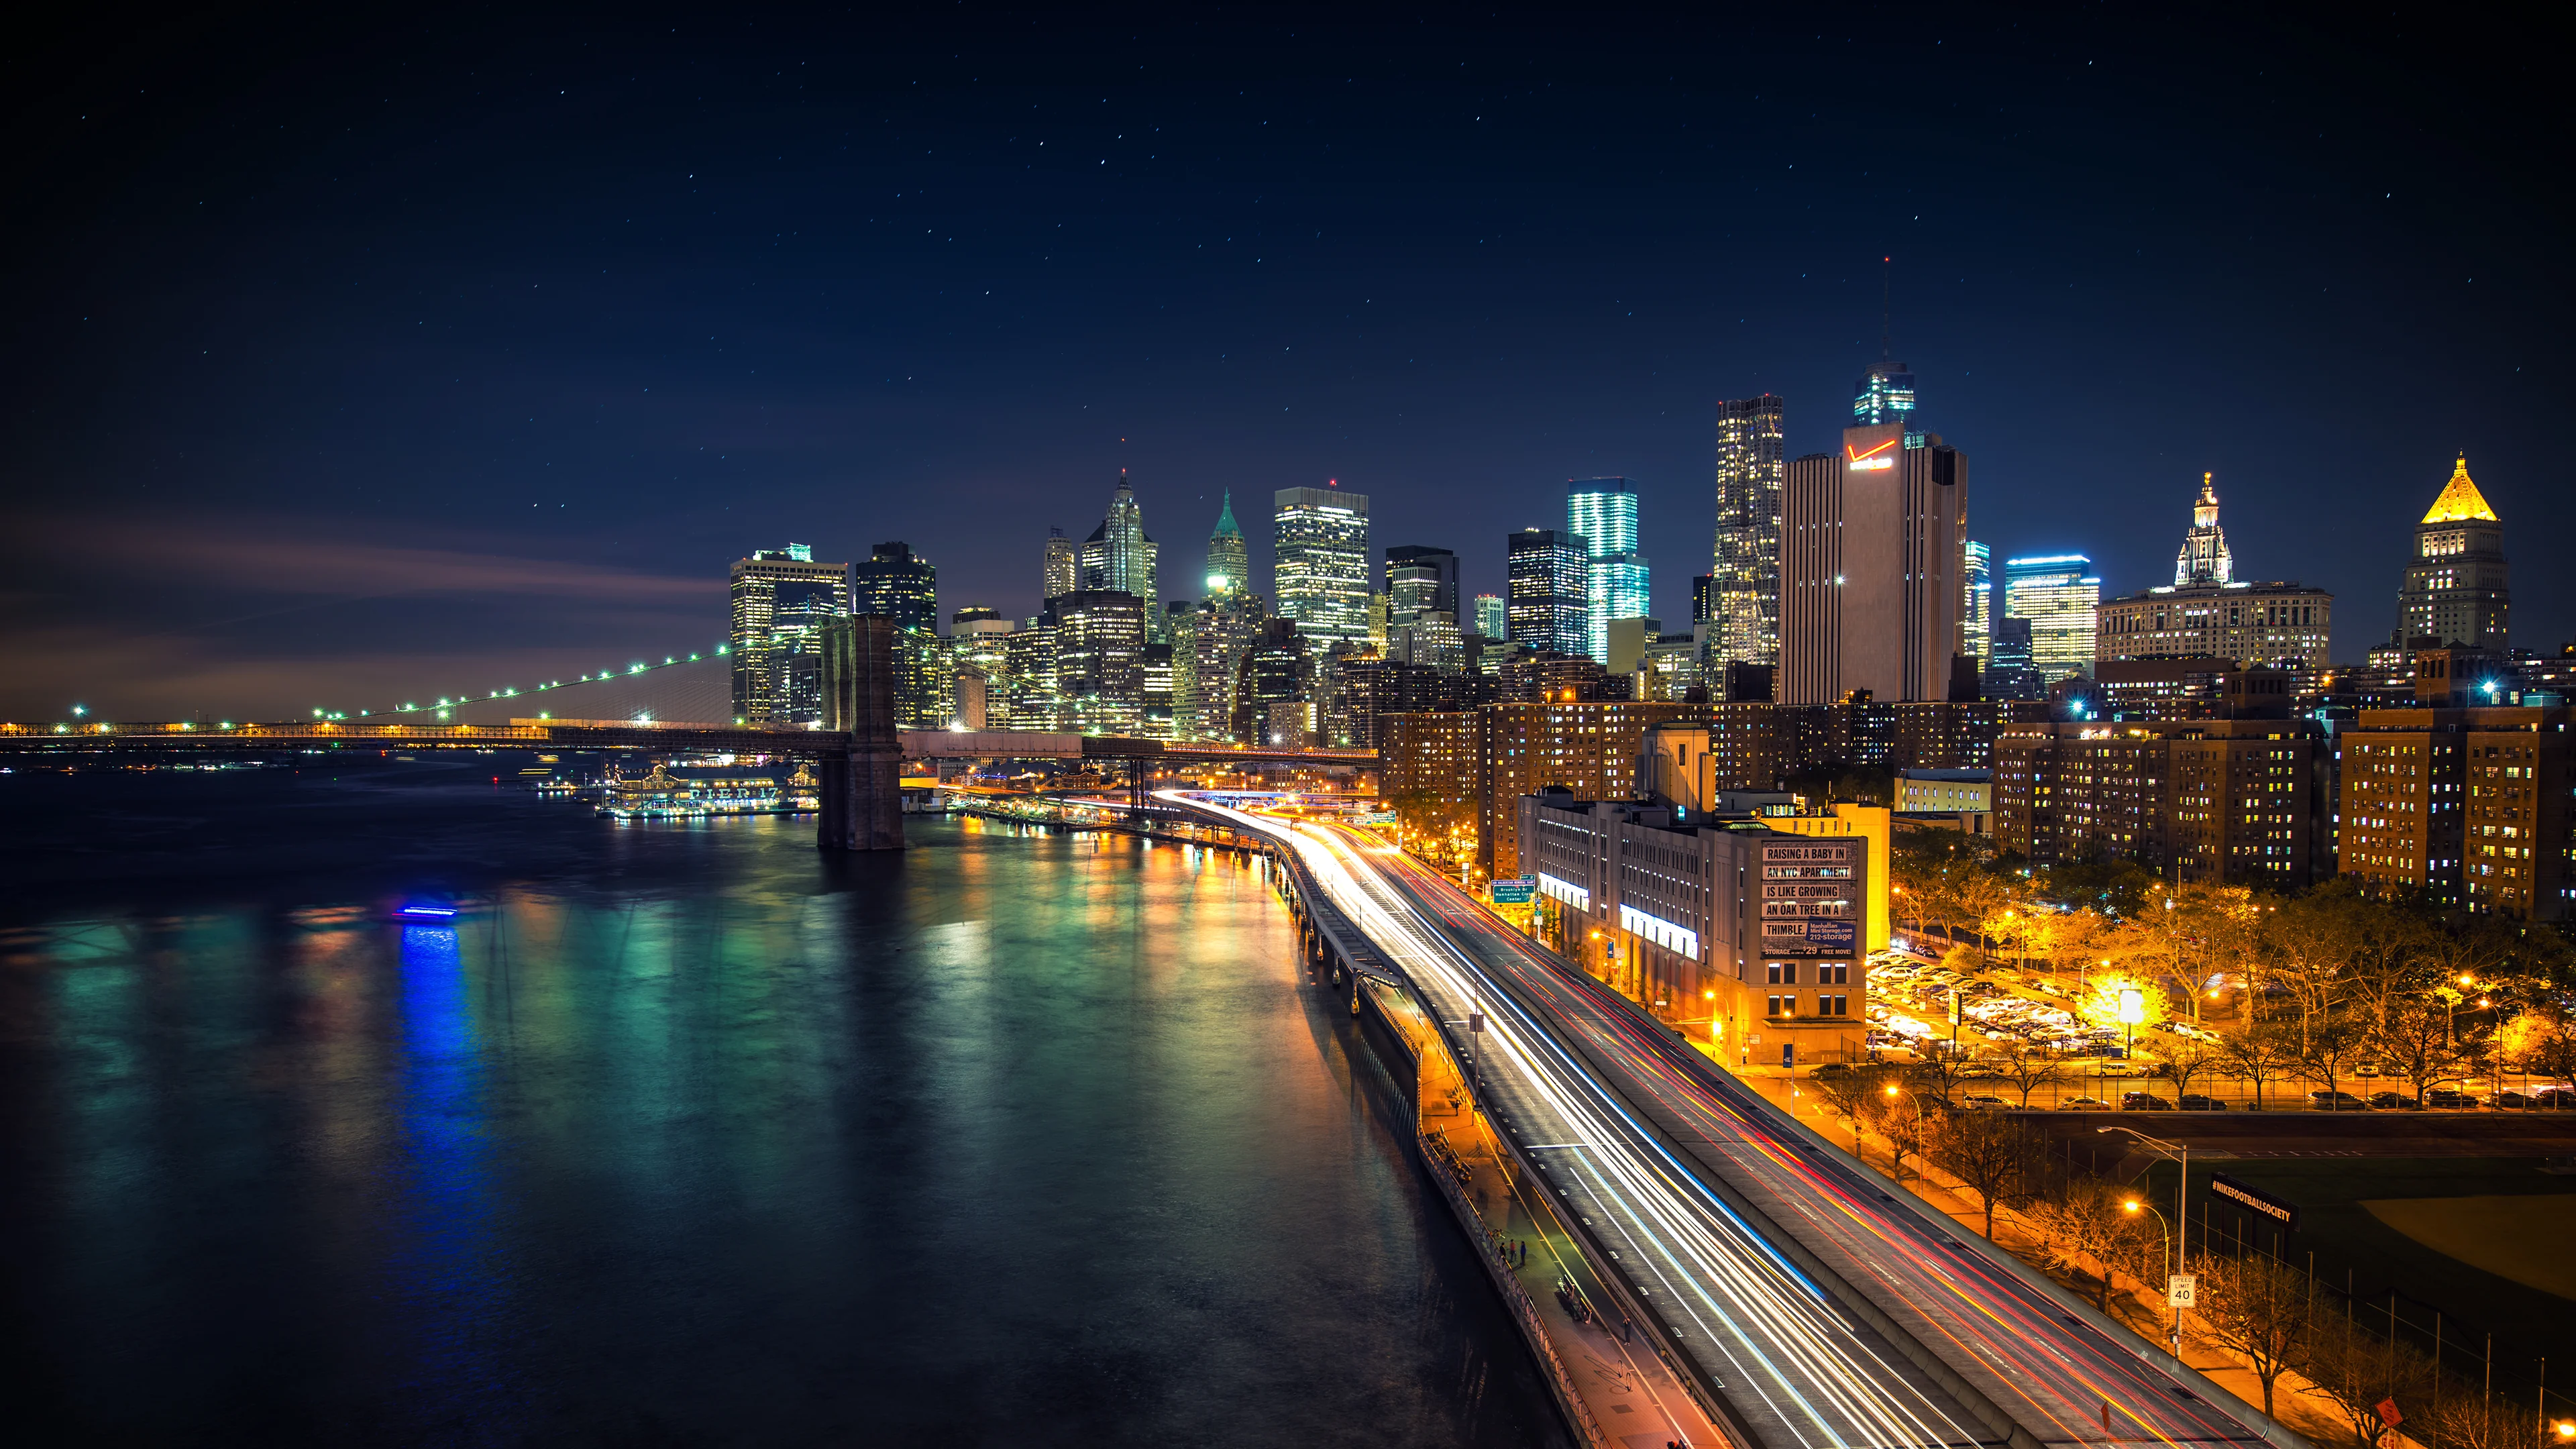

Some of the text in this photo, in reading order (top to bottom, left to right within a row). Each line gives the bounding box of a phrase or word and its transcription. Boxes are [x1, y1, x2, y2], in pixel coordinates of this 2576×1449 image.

[689, 787, 778, 799] PIER 17
[1768, 849, 1844, 859] RAISING A BABY IN
[1767, 867, 1849, 877] AN NYC APARTMENT
[1767, 886, 1837, 897] IS LIKE GROWING
[1766, 905, 1839, 915] AN OAK TREE IN A
[1766, 924, 1805, 935] THIMBLE.
[1803, 946, 1817, 955] $29
[2212, 1180, 2290, 1222] #NIKEFOOTBALLSOCIETY
[2175, 1290, 2190, 1299] 40
